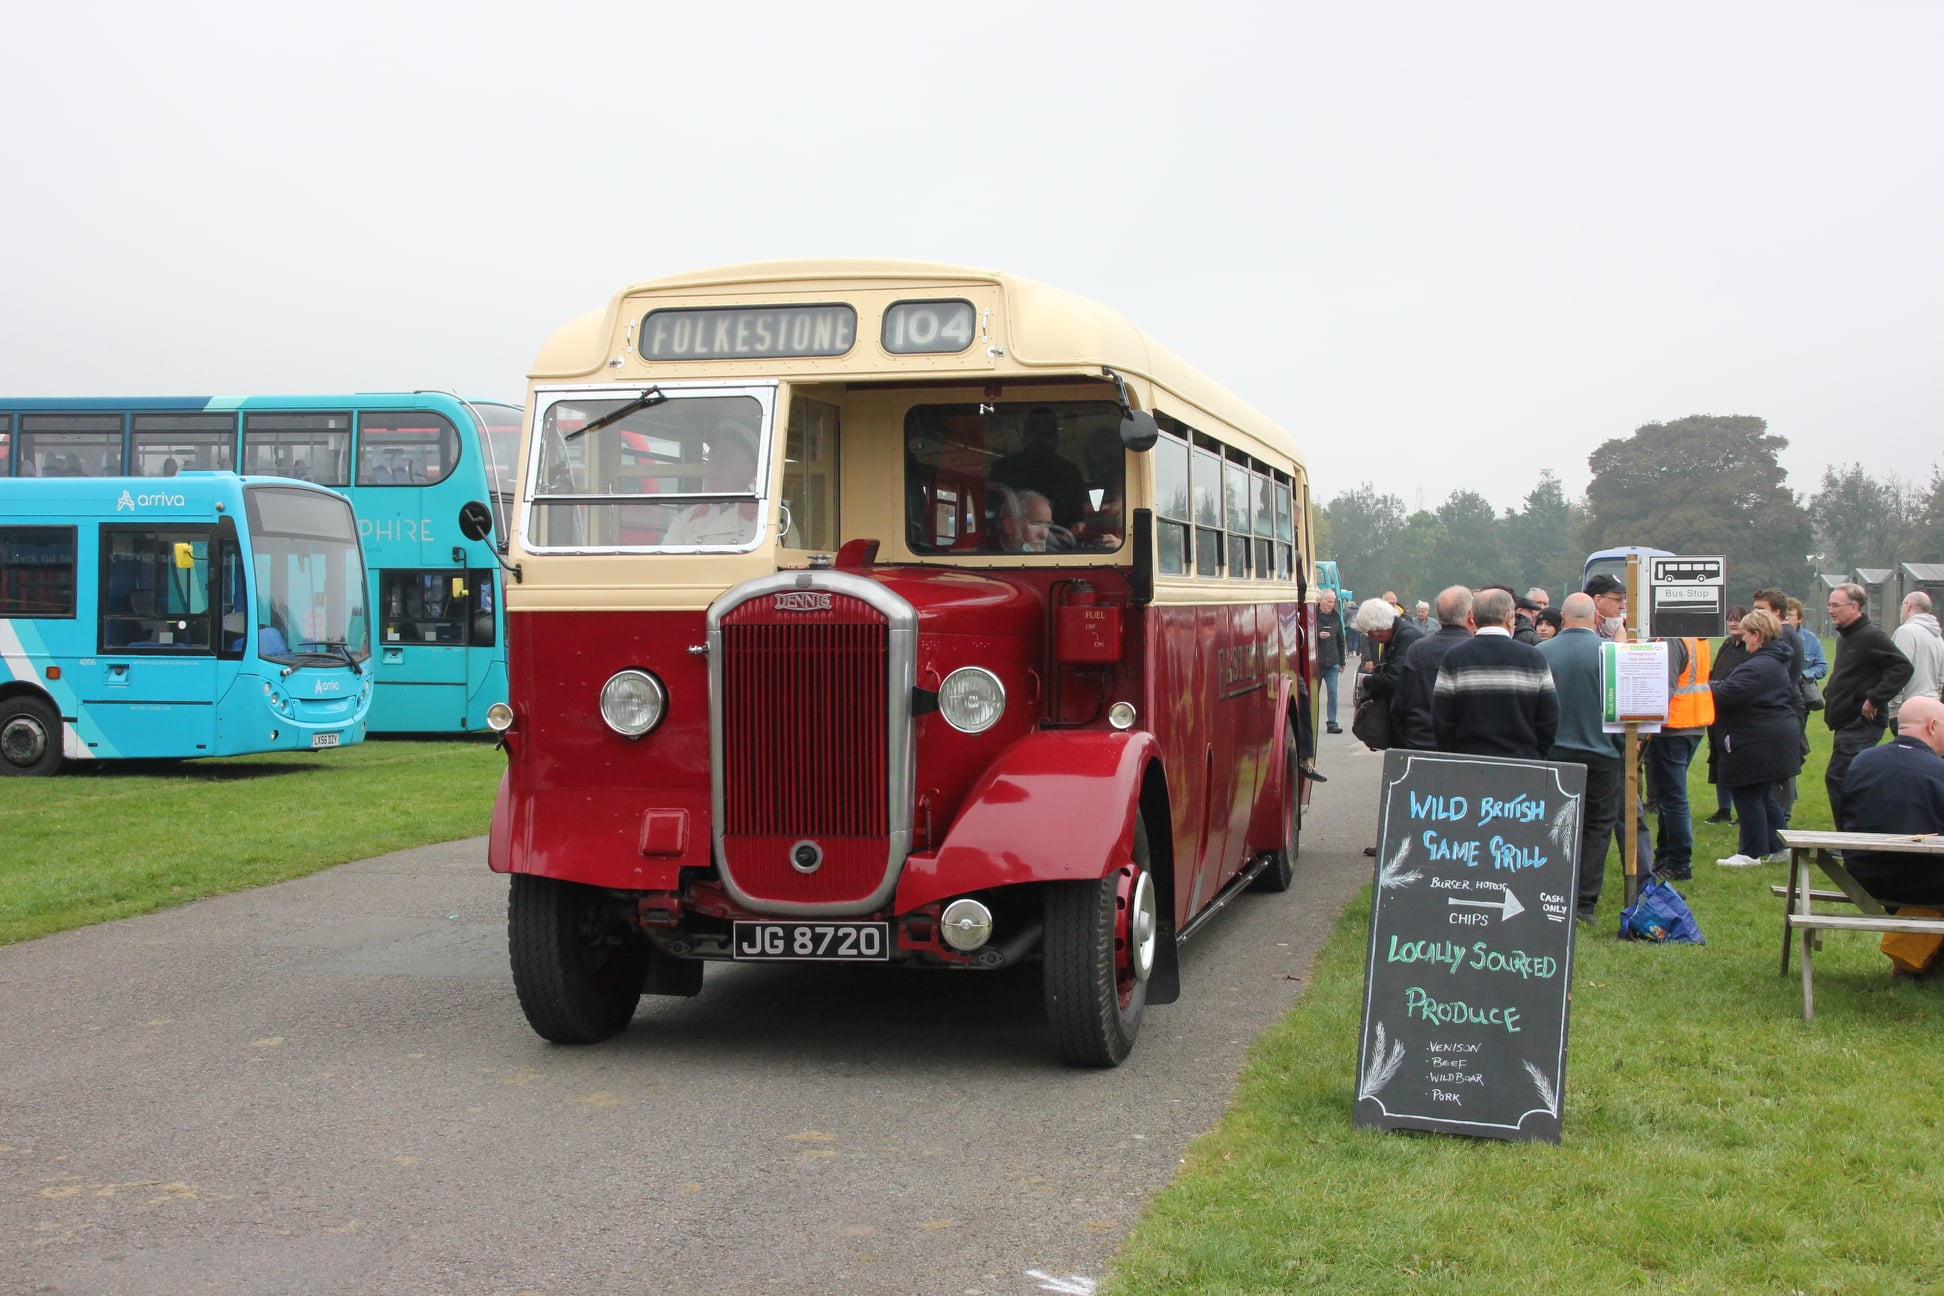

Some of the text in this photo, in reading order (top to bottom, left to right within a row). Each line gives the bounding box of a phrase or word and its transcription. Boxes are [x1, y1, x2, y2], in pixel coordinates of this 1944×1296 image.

[652, 308, 973, 354] FOLKESTONE 104
[138, 491, 185, 507] arriva
[777, 592, 831, 610] DENNIS
[1665, 589, 1709, 599] Bus Stop
[1085, 610, 1105, 619] FUEL
[1410, 791, 1546, 827] WILD BRITISH
[1422, 830, 1548, 873] GAME GRILL
[1539, 892, 1564, 903] CASH
[1542, 903, 1568, 914] ONLY
[1449, 912, 1489, 926] CHIPS
[742, 926, 880, 956] JG 8720
[1387, 935, 1557, 979] LOCALLY SOURCED
[1405, 986, 1522, 1034] PRODUCE
[1429, 1041, 1482, 1053] VENISON
[1433, 1057, 1468, 1068] BEEF
[1432, 1089, 1461, 1105] PORK
